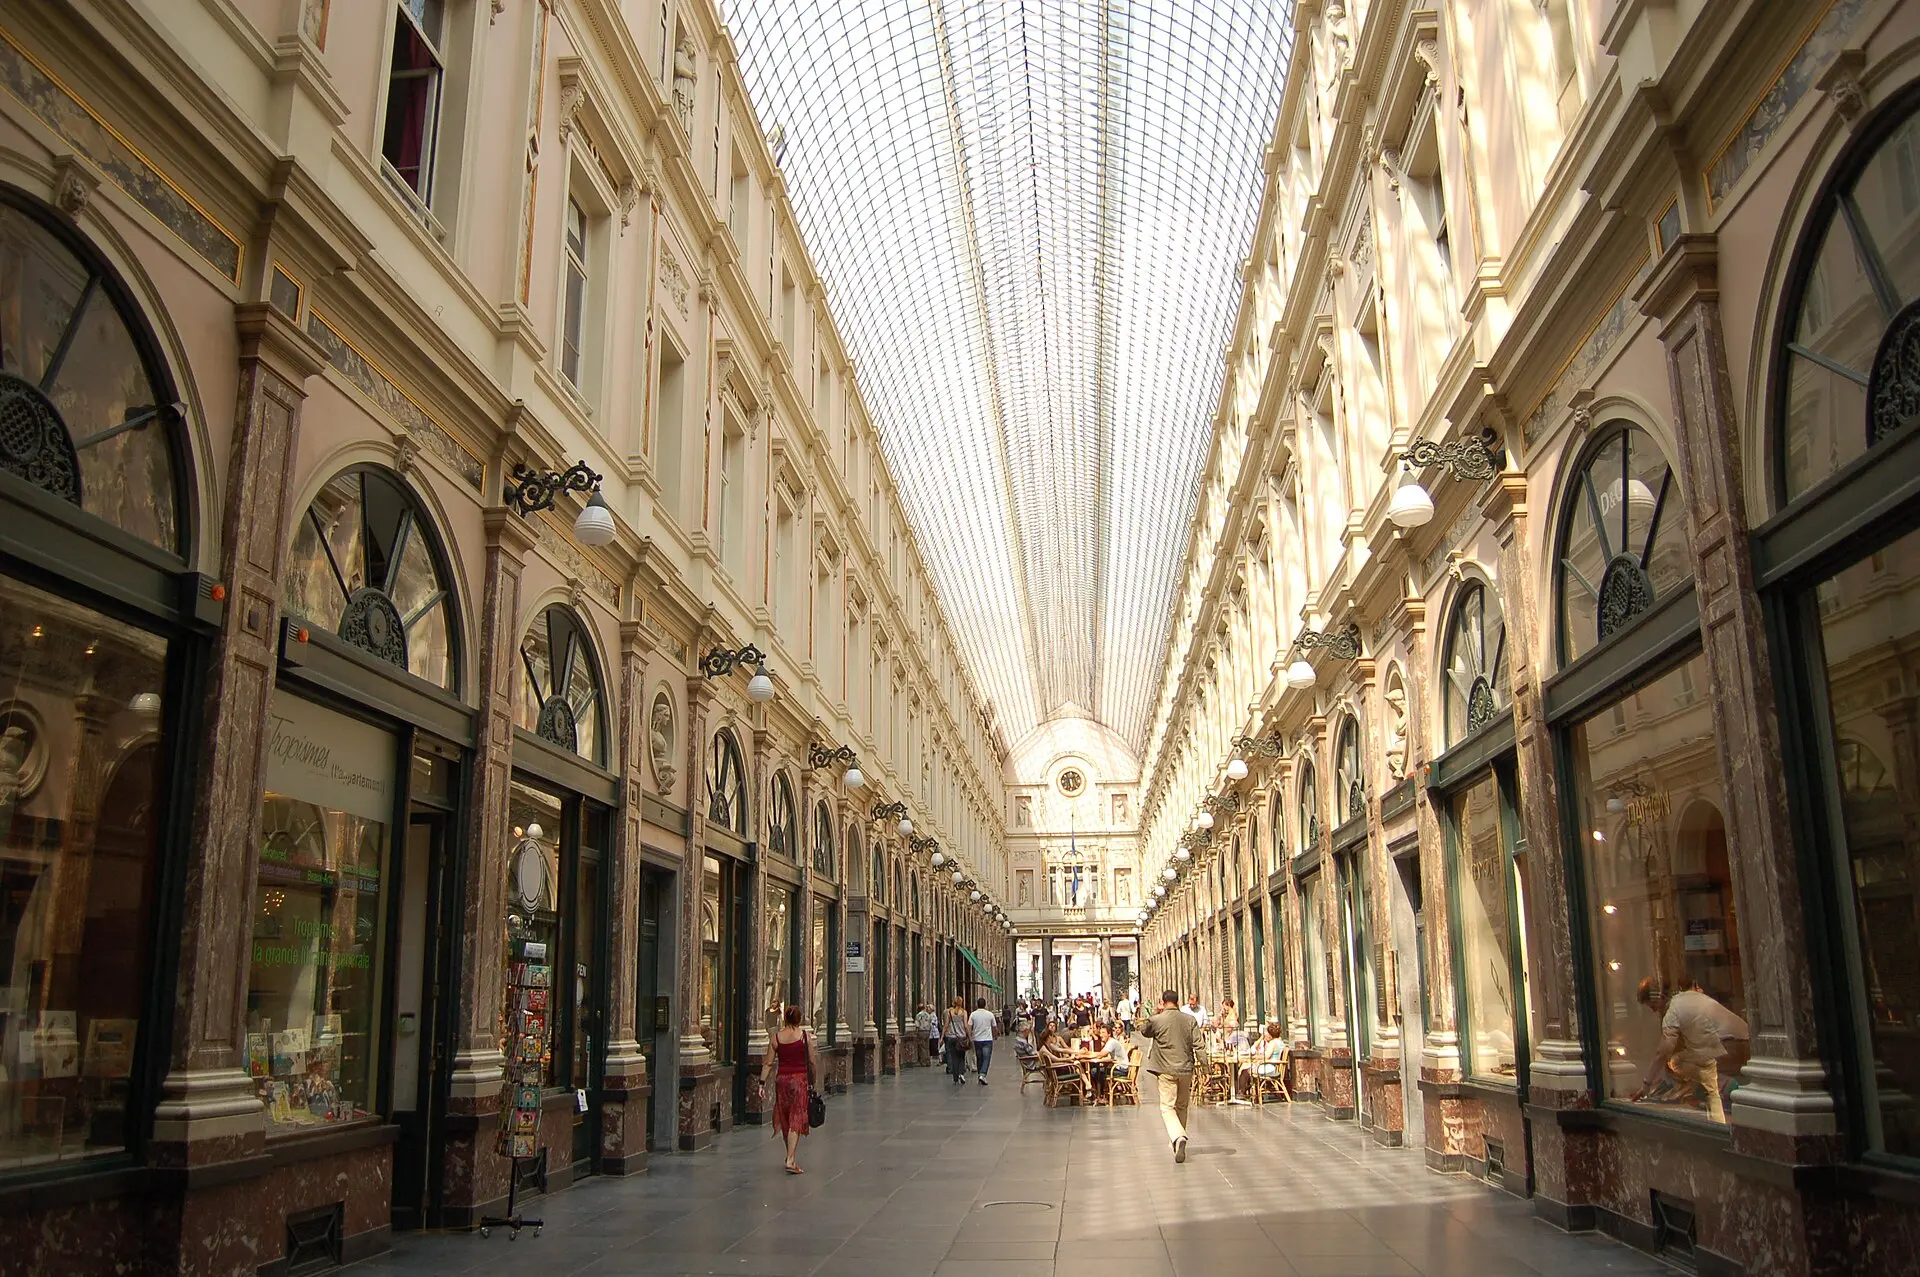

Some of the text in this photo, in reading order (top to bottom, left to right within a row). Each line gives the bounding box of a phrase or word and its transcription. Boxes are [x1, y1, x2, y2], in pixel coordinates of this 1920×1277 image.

[267, 713, 331, 770] Tropismes
[253, 942, 262, 962] la
[265, 945, 298, 966] grande
[576, 963, 587, 977] PEN
